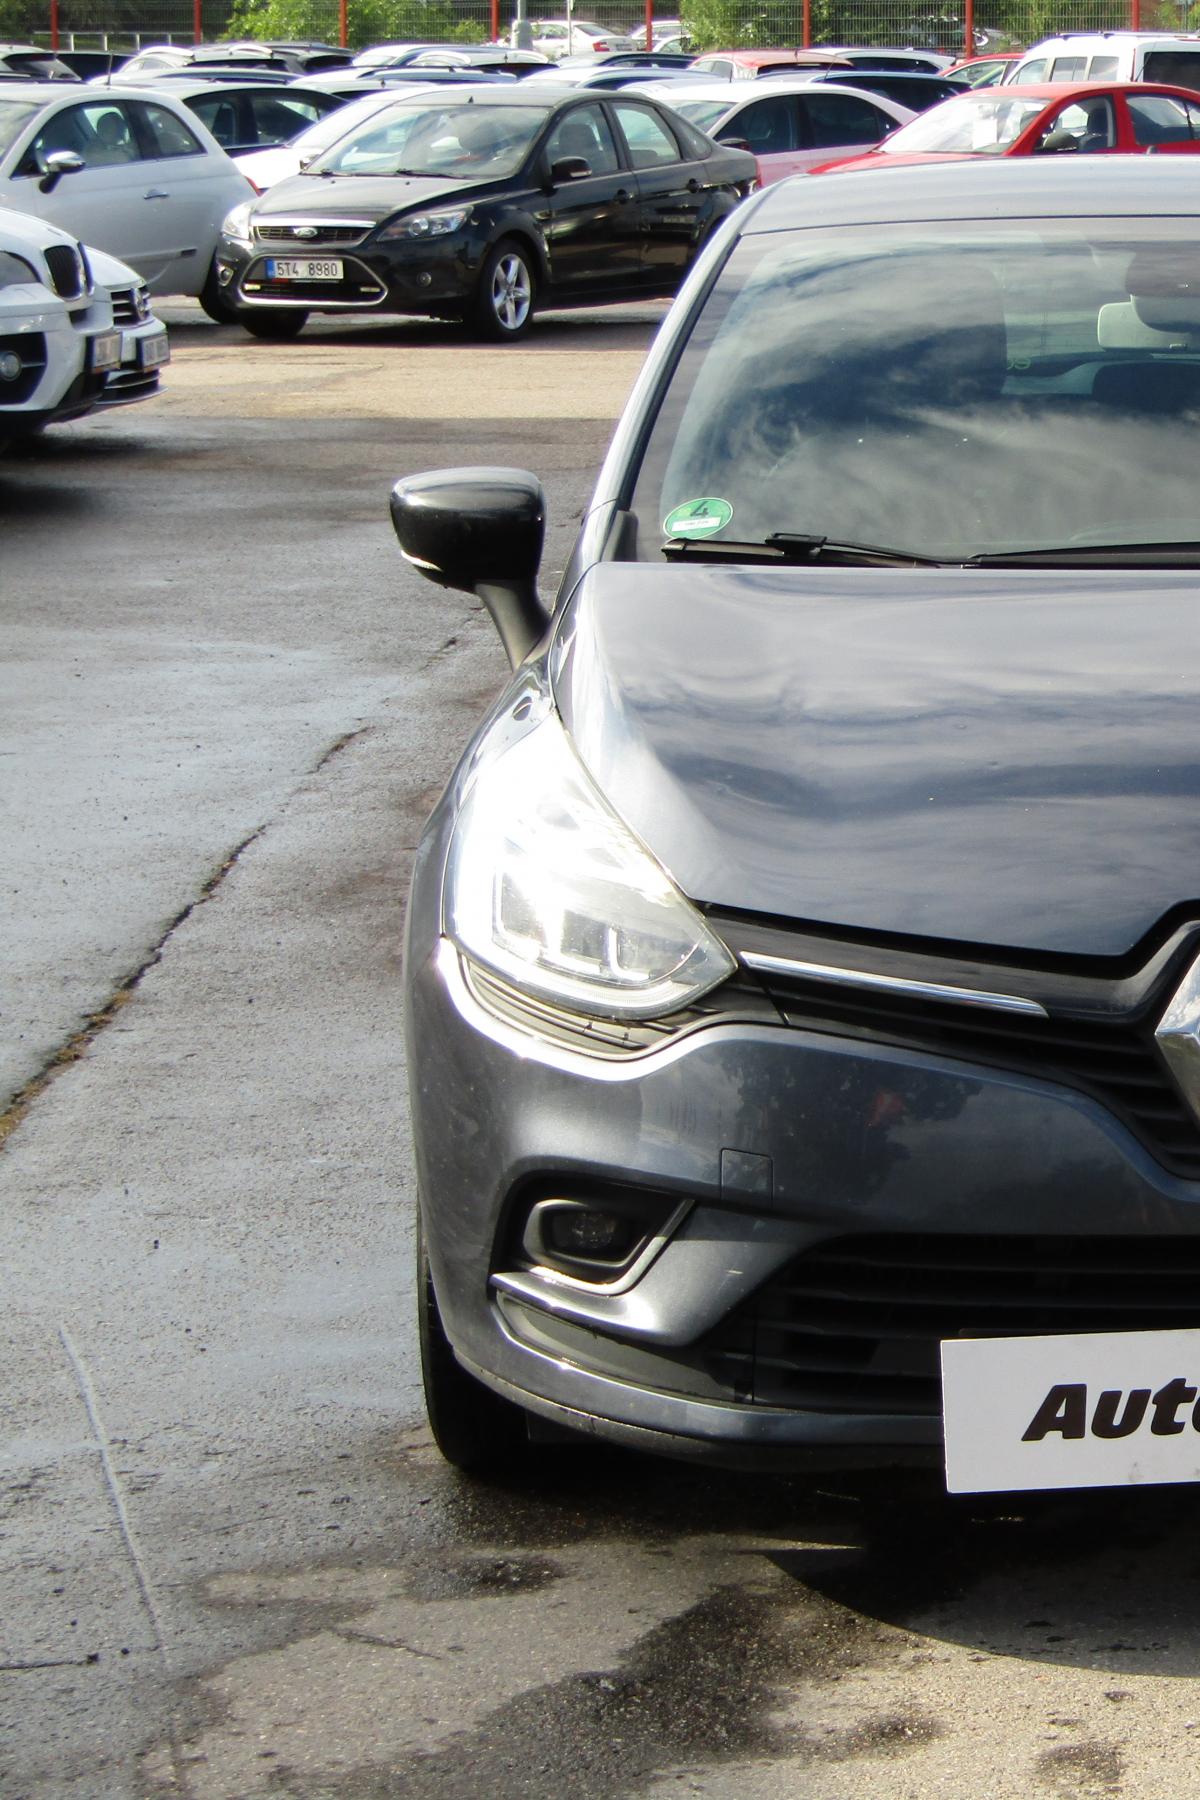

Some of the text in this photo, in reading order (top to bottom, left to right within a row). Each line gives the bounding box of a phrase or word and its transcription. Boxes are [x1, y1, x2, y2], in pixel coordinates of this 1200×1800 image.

[277, 262, 338, 276] 5T4 8980
[690, 501, 709, 517] 4
